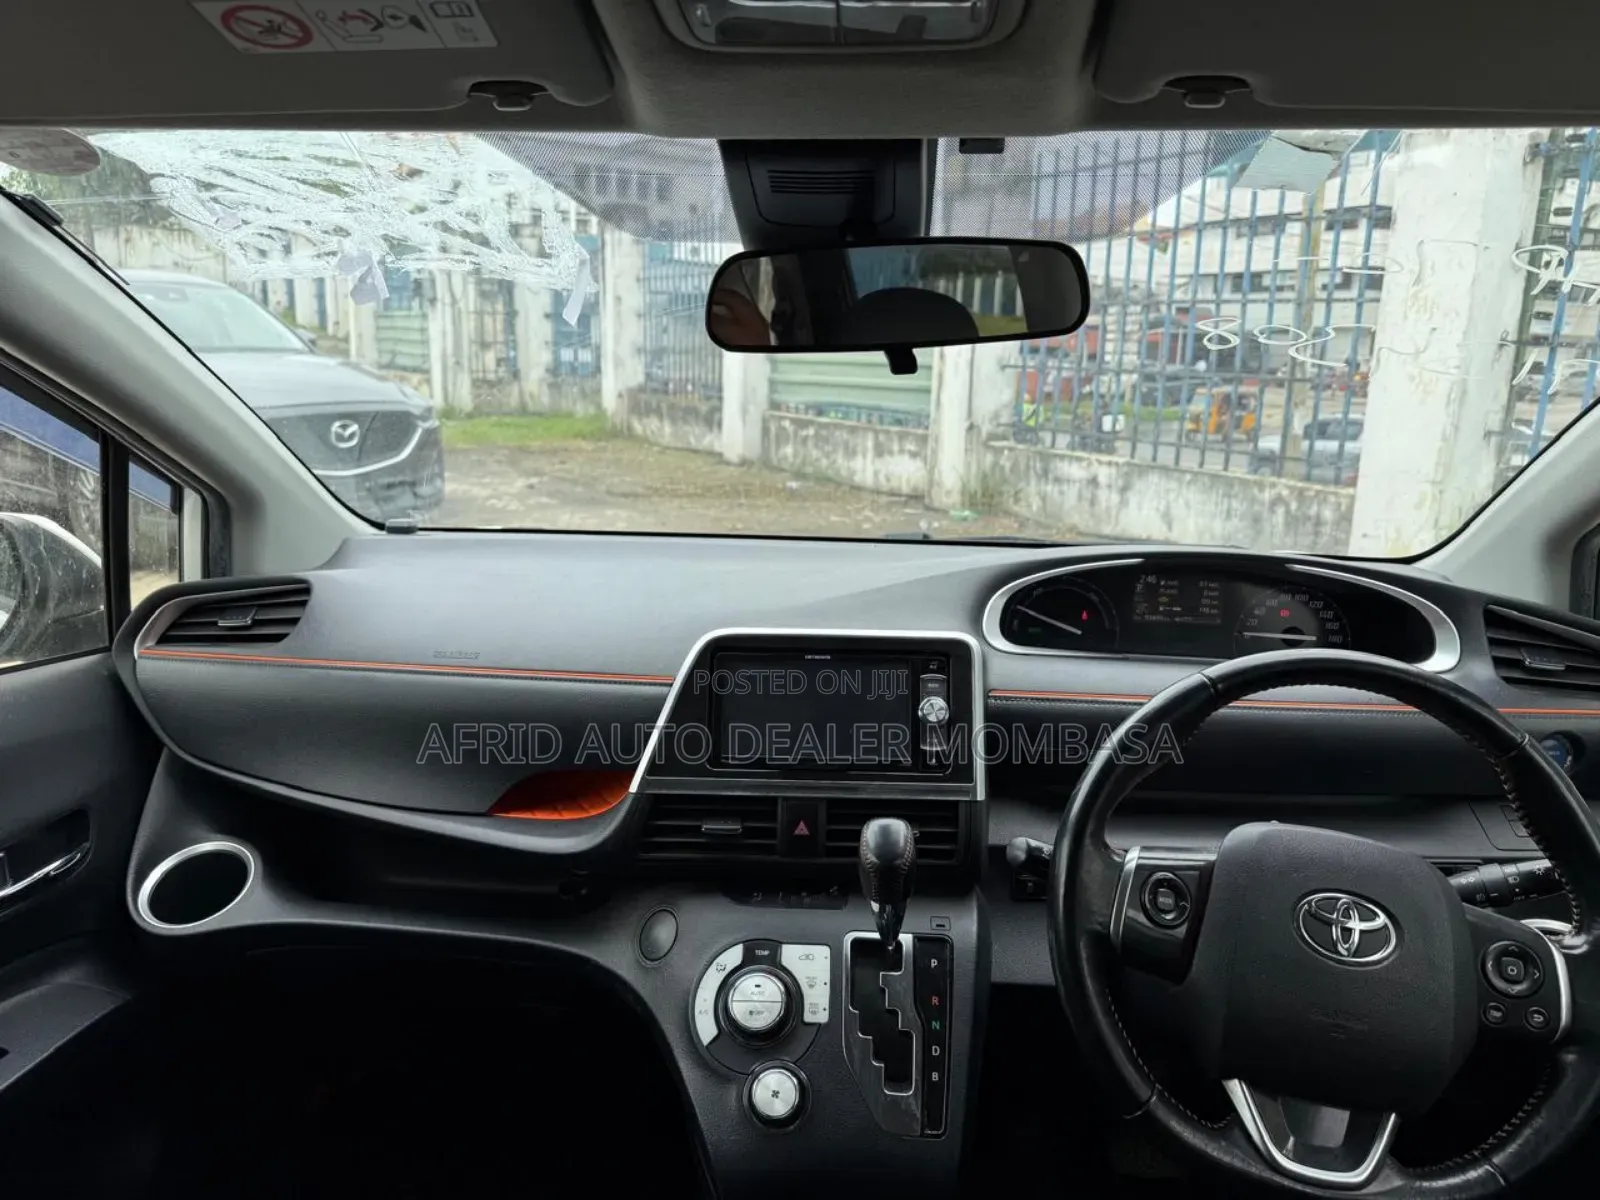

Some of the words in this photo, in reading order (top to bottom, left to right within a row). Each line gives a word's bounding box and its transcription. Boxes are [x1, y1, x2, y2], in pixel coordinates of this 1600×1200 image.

[930, 958, 939, 969] P
[931, 995, 940, 1006] R
[931, 1020, 940, 1031] N
[931, 1045, 941, 1056] D
[931, 1071, 940, 1082] B
